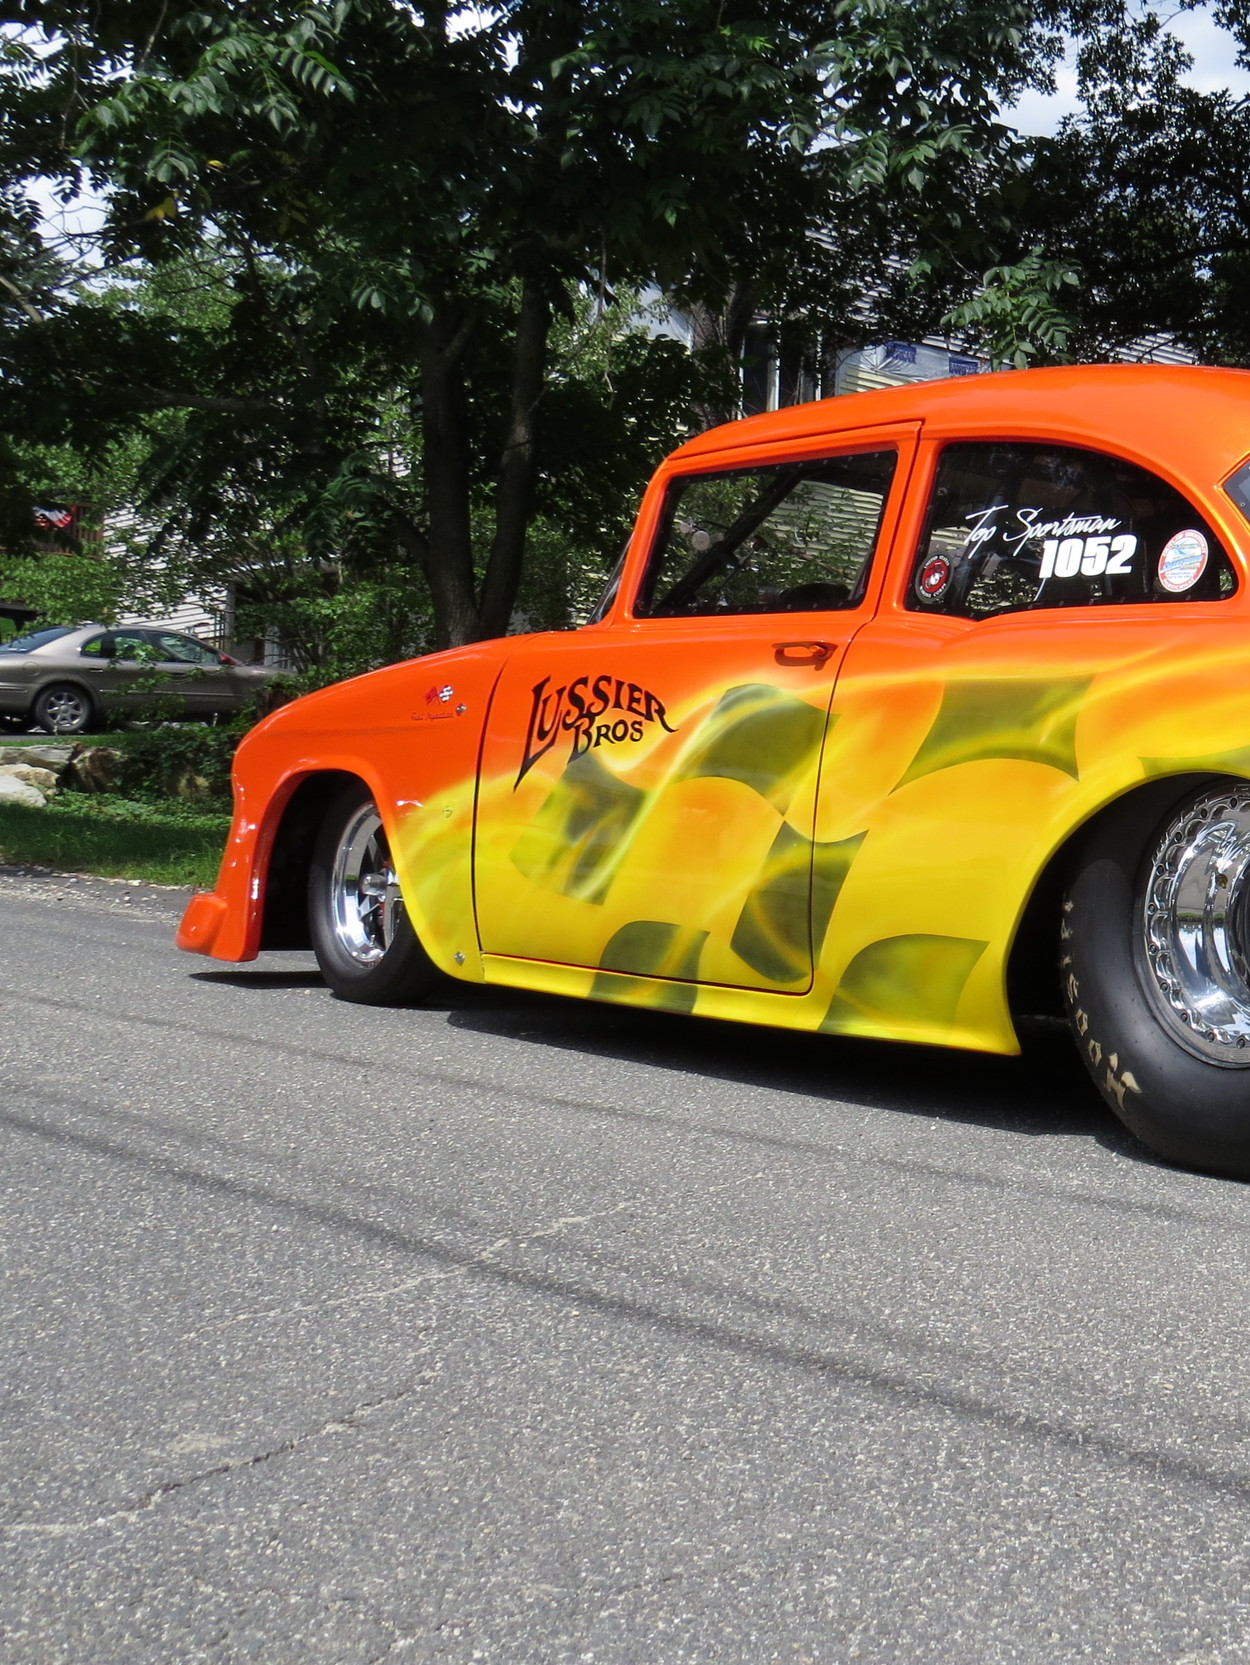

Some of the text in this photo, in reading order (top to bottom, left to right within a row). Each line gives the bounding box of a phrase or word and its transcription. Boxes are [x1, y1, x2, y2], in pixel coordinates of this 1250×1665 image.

[965, 504, 1009, 559] Top
[1002, 507, 1122, 557] Sportsman
[1038, 534, 1137, 579] 1052
[513, 674, 679, 794] LUSSIER
